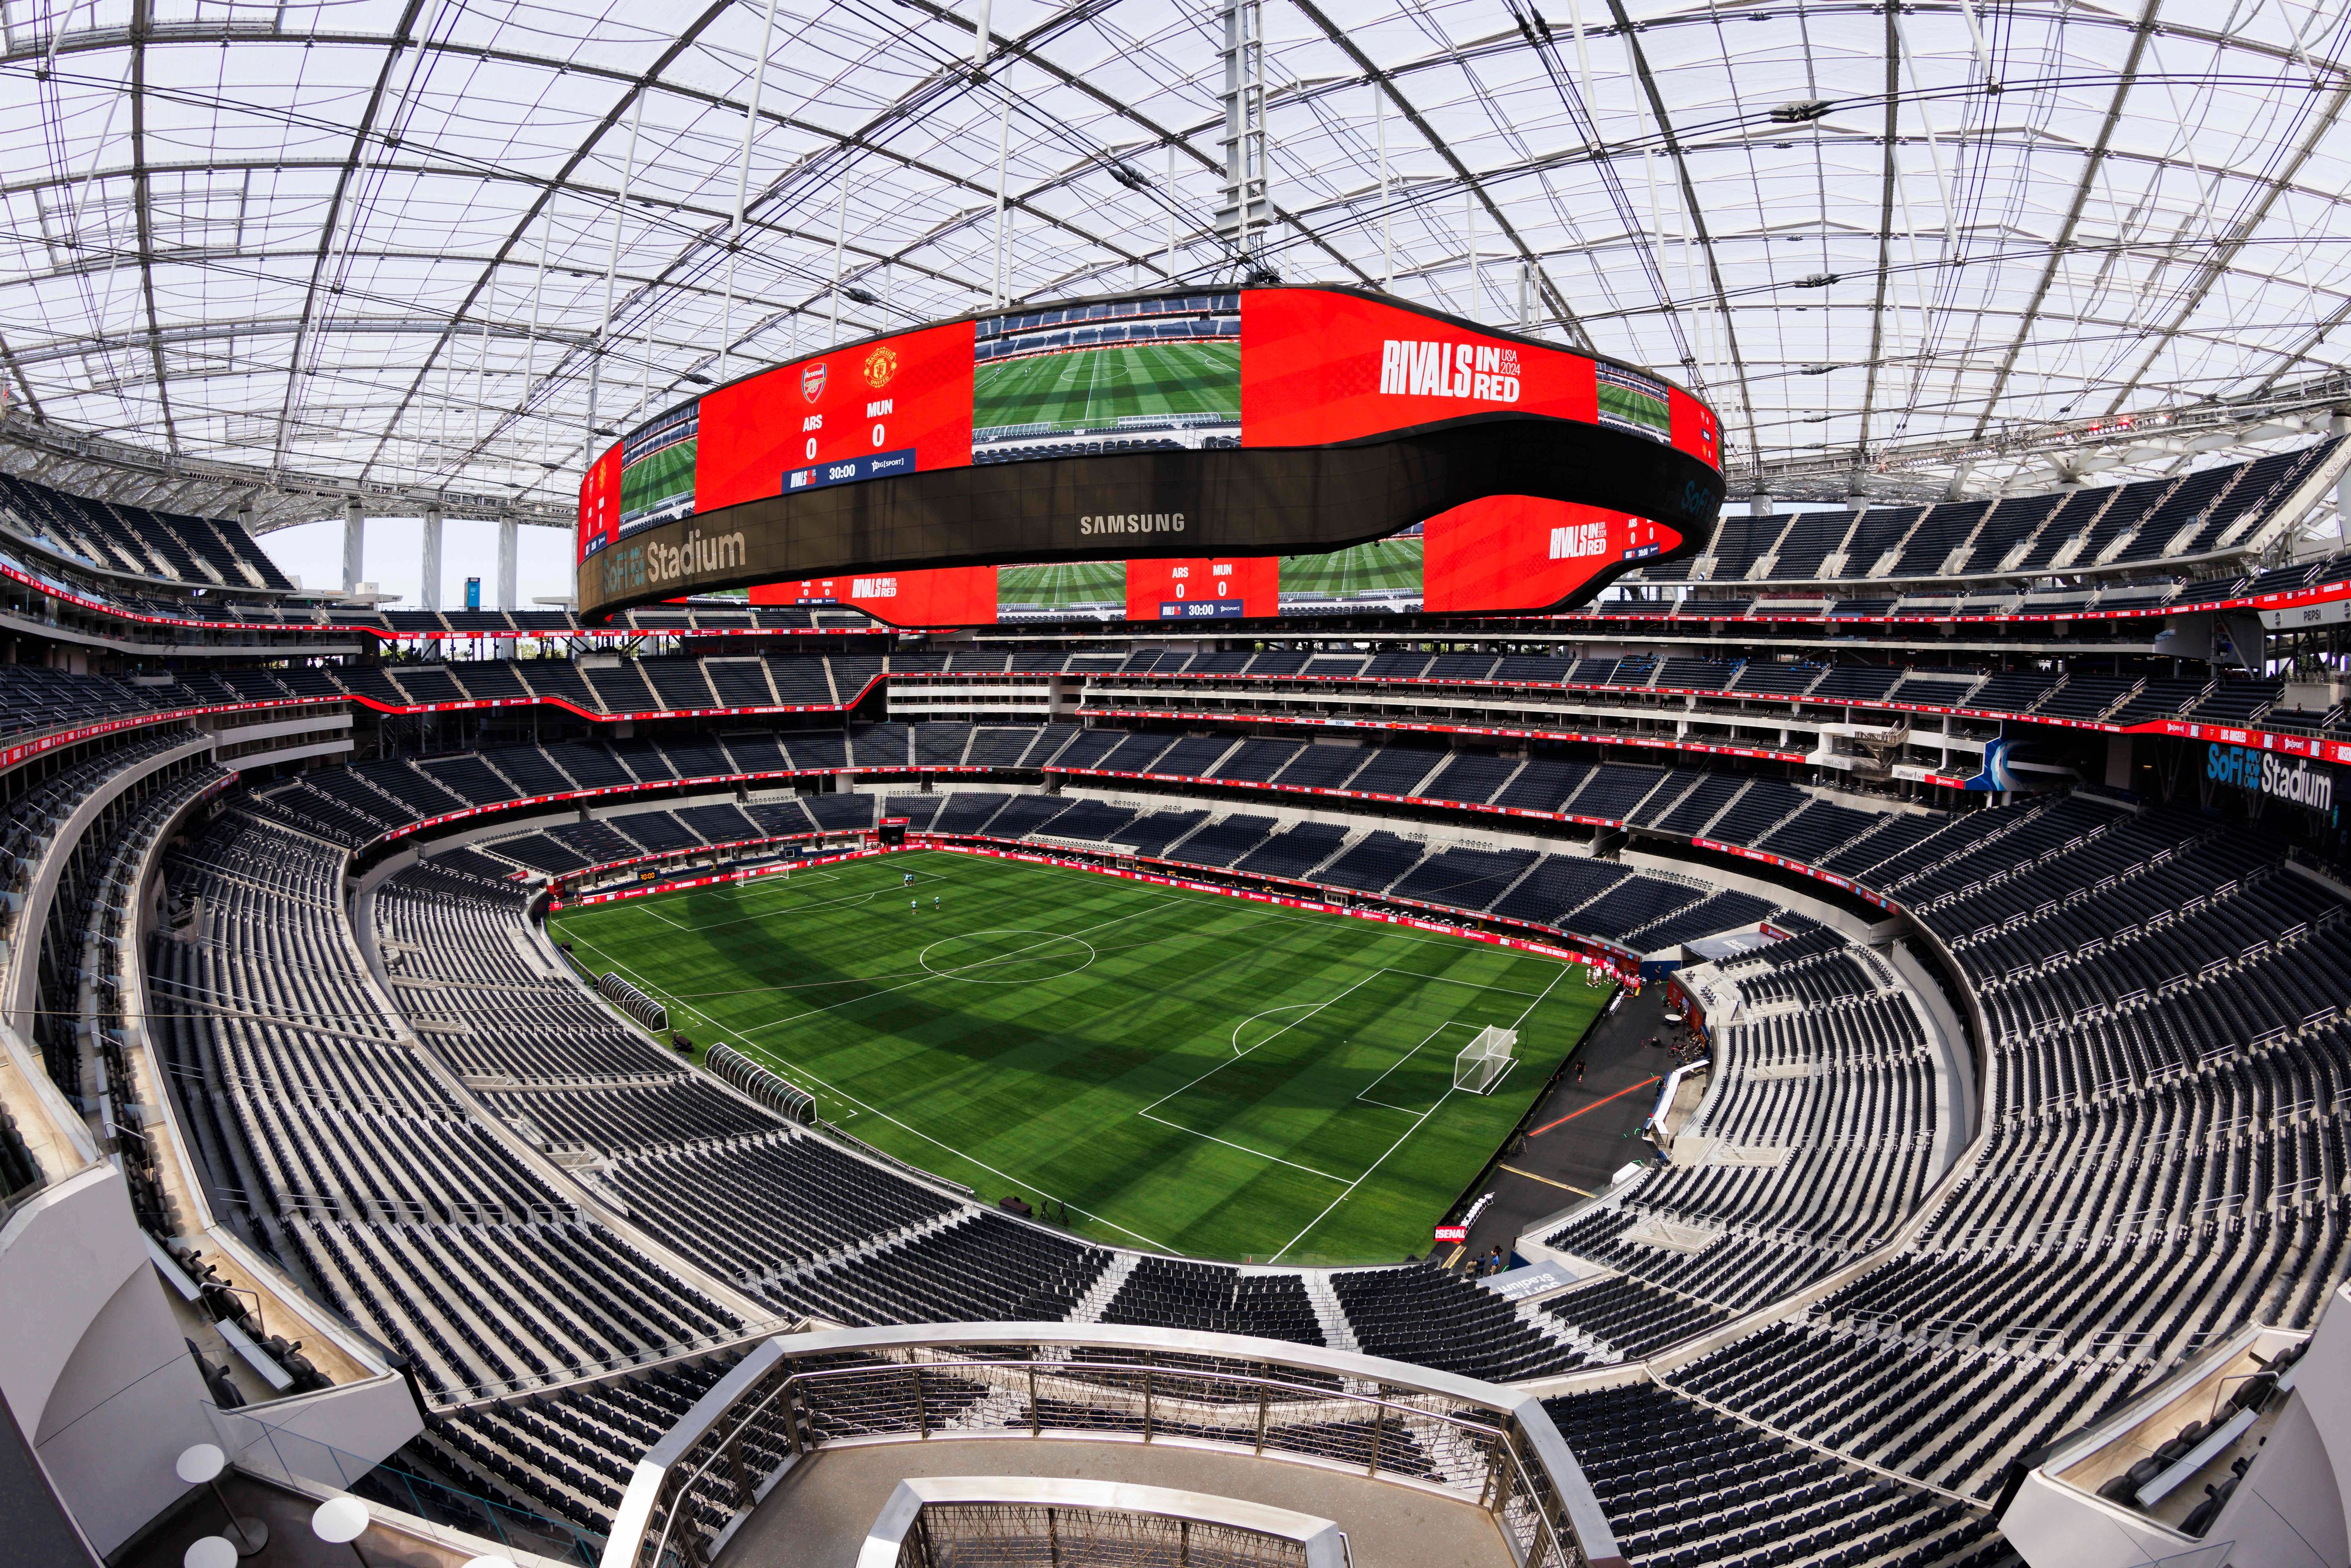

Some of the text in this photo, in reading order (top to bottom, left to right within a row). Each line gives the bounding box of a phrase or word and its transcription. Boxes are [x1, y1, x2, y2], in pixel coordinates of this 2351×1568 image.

[868, 350, 893, 365] MANCHESTER
[1502, 349, 1517, 362] USA
[805, 368, 823, 378] Arsenal
[1380, 340, 1500, 398] RIVALS IN
[1501, 362, 1520, 376] 2024
[870, 376, 889, 385] UNITED
[1473, 373, 1519, 403] RED
[867, 399, 893, 418] MUN
[803, 414, 822, 432] ARS
[872, 424, 885, 447] 0
[806, 438, 816, 460] 0
[829, 464, 855, 480] 30:00
[1080, 512, 1185, 535] SAMSUNG
[1628, 518, 1637, 528] ARS
[1549, 522, 1599, 559] RIVALS IN
[1598, 529, 1607, 538] 2024
[1630, 532, 1635, 545] 0
[1649, 527, 1653, 540] 0
[1587, 538, 1606, 556] RED
[603, 529, 745, 595] SoFi Stadium
[1172, 567, 1188, 578] ARS
[1213, 564, 1232, 576] MUN
[852, 578, 890, 598] RIVALS IN
[881, 588, 896, 597] RED
[1176, 583, 1184, 598] 0
[1218, 581, 1227, 597] 0
[1188, 604, 1214, 616] 30:00
[2304, 609, 2322, 621] PEPSI
[2229, 730, 2246, 743] ANGELES
[2208, 743, 2332, 811] SoFi Stadium
[640, 872, 655, 880] 30:00
[1415, 921, 1431, 929] ARSENAL
[1436, 924, 1451, 933] UNITED
[1529, 943, 1546, 953] ARSENAL
[1552, 949, 1568, 958] UNITED
[1497, 1273, 1555, 1293] Stadium
